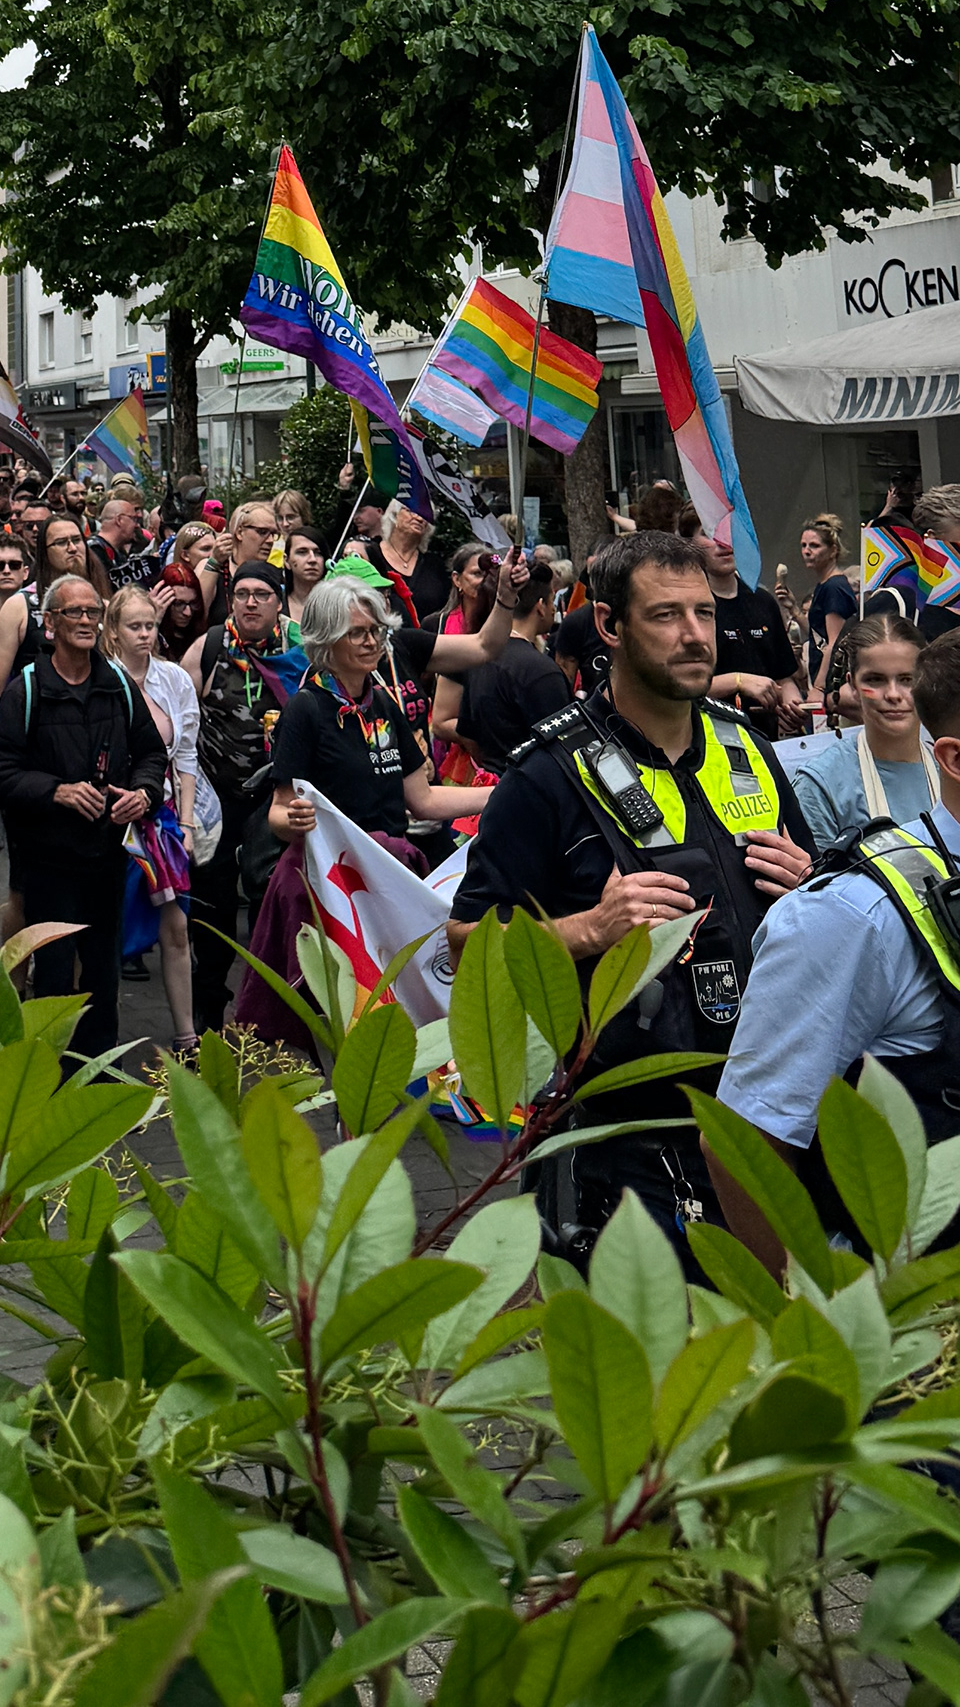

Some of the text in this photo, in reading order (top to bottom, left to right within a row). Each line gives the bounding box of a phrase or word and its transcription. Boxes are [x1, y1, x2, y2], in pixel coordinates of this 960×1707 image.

[257, 275, 302, 310] Wir
[843, 258, 960, 318] KOCKEN
[245, 348, 275, 357] GEERS
[112, 565, 152, 589] YOUR
[720, 793, 774, 823] POLIZEI
